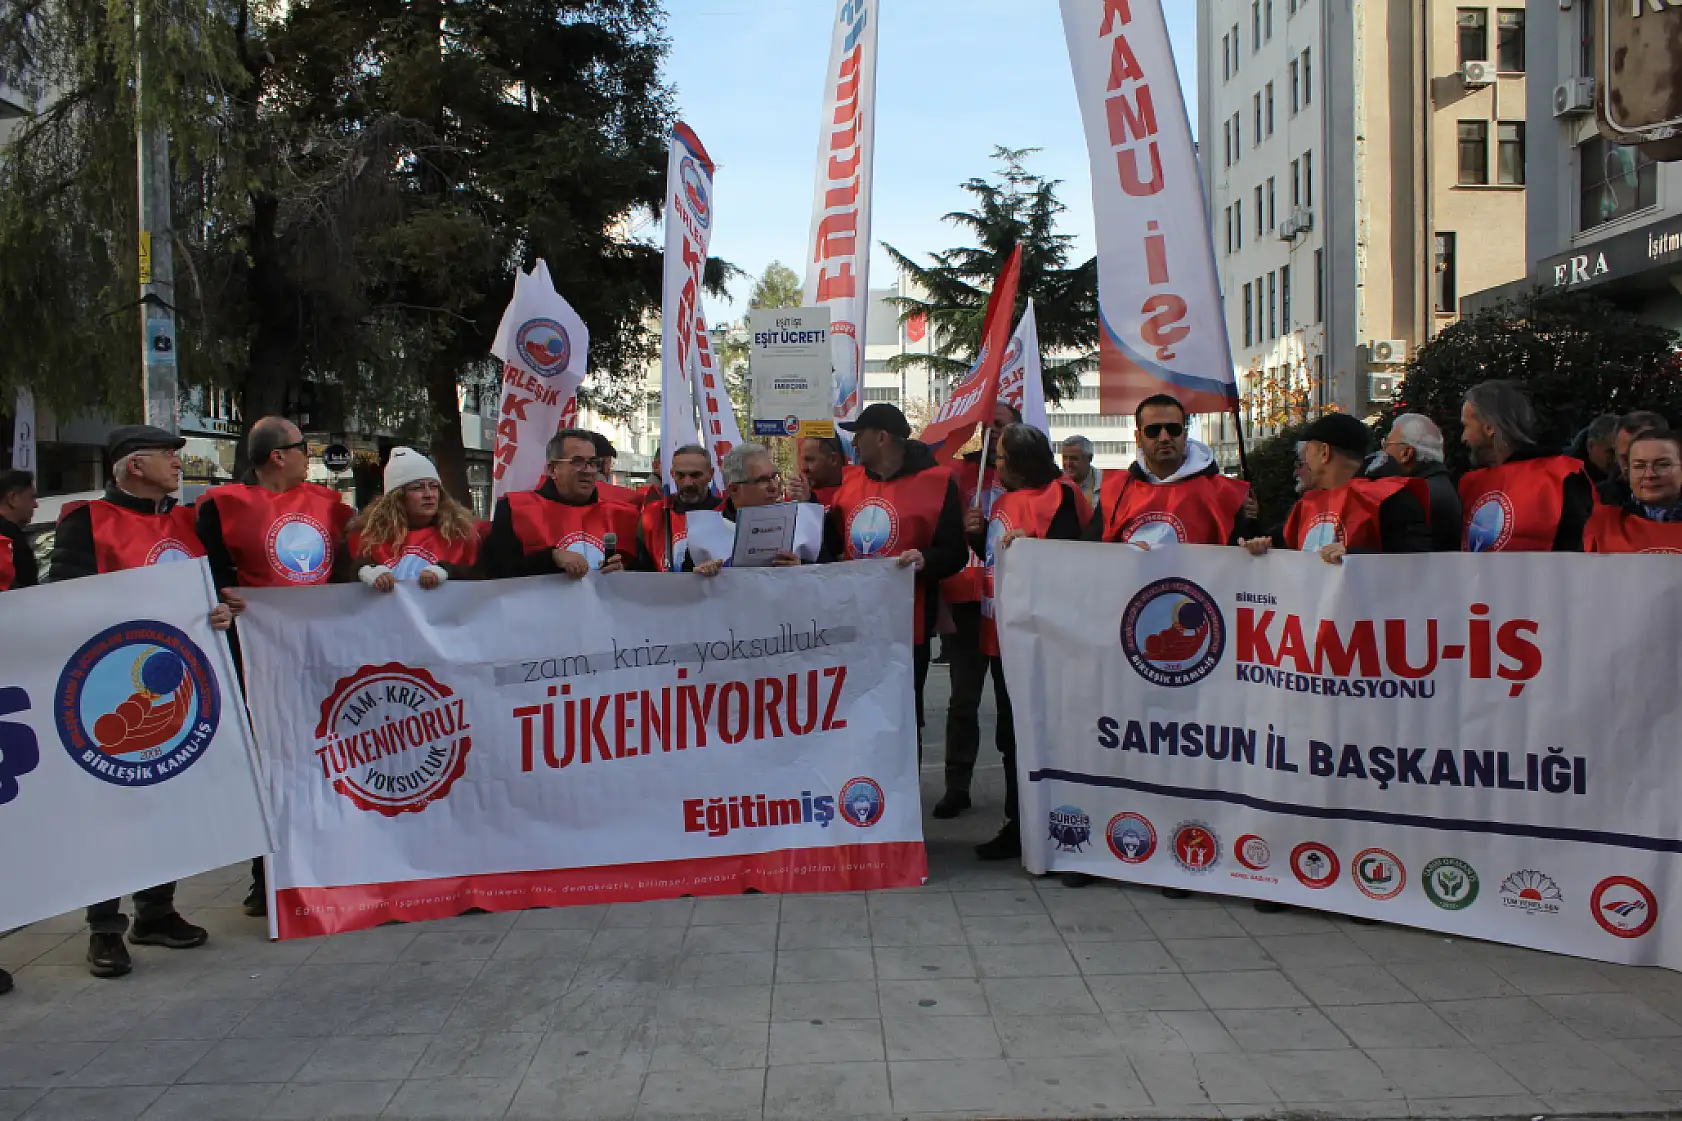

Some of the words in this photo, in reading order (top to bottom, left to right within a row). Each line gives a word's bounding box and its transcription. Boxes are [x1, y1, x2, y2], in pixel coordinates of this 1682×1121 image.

[1553, 251, 1610, 287] ERA
[1647, 231, 1682, 260] İşitm
[755, 328, 779, 348] EŞİT
[781, 328, 825, 344] ÜCRET!
[503, 359, 561, 406] İRLEŞİK
[1236, 591, 1278, 606] BİRLEŞİK
[521, 653, 598, 683] zam,
[612, 637, 677, 670] kriz,
[694, 620, 831, 673] yoksulluk
[1236, 602, 1543, 697] KAMU-İŞ
[1236, 664, 1436, 699] KONFEDERASYONU
[342, 691, 378, 726] ZAM
[386, 685, 426, 712] KRİZ
[512, 665, 848, 772] TÜKENİYORUZ
[82, 750, 153, 783] BİRLEŞİK
[156, 721, 212, 776] KAMU-İŞ
[315, 699, 471, 779] TÜKENİYORUZ
[1097, 716, 1256, 765] SAMSUN
[1266, 723, 1298, 773] İL
[1309, 739, 1587, 795] BAŞKANLIĞI
[365, 745, 447, 793] YOKSULLUK
